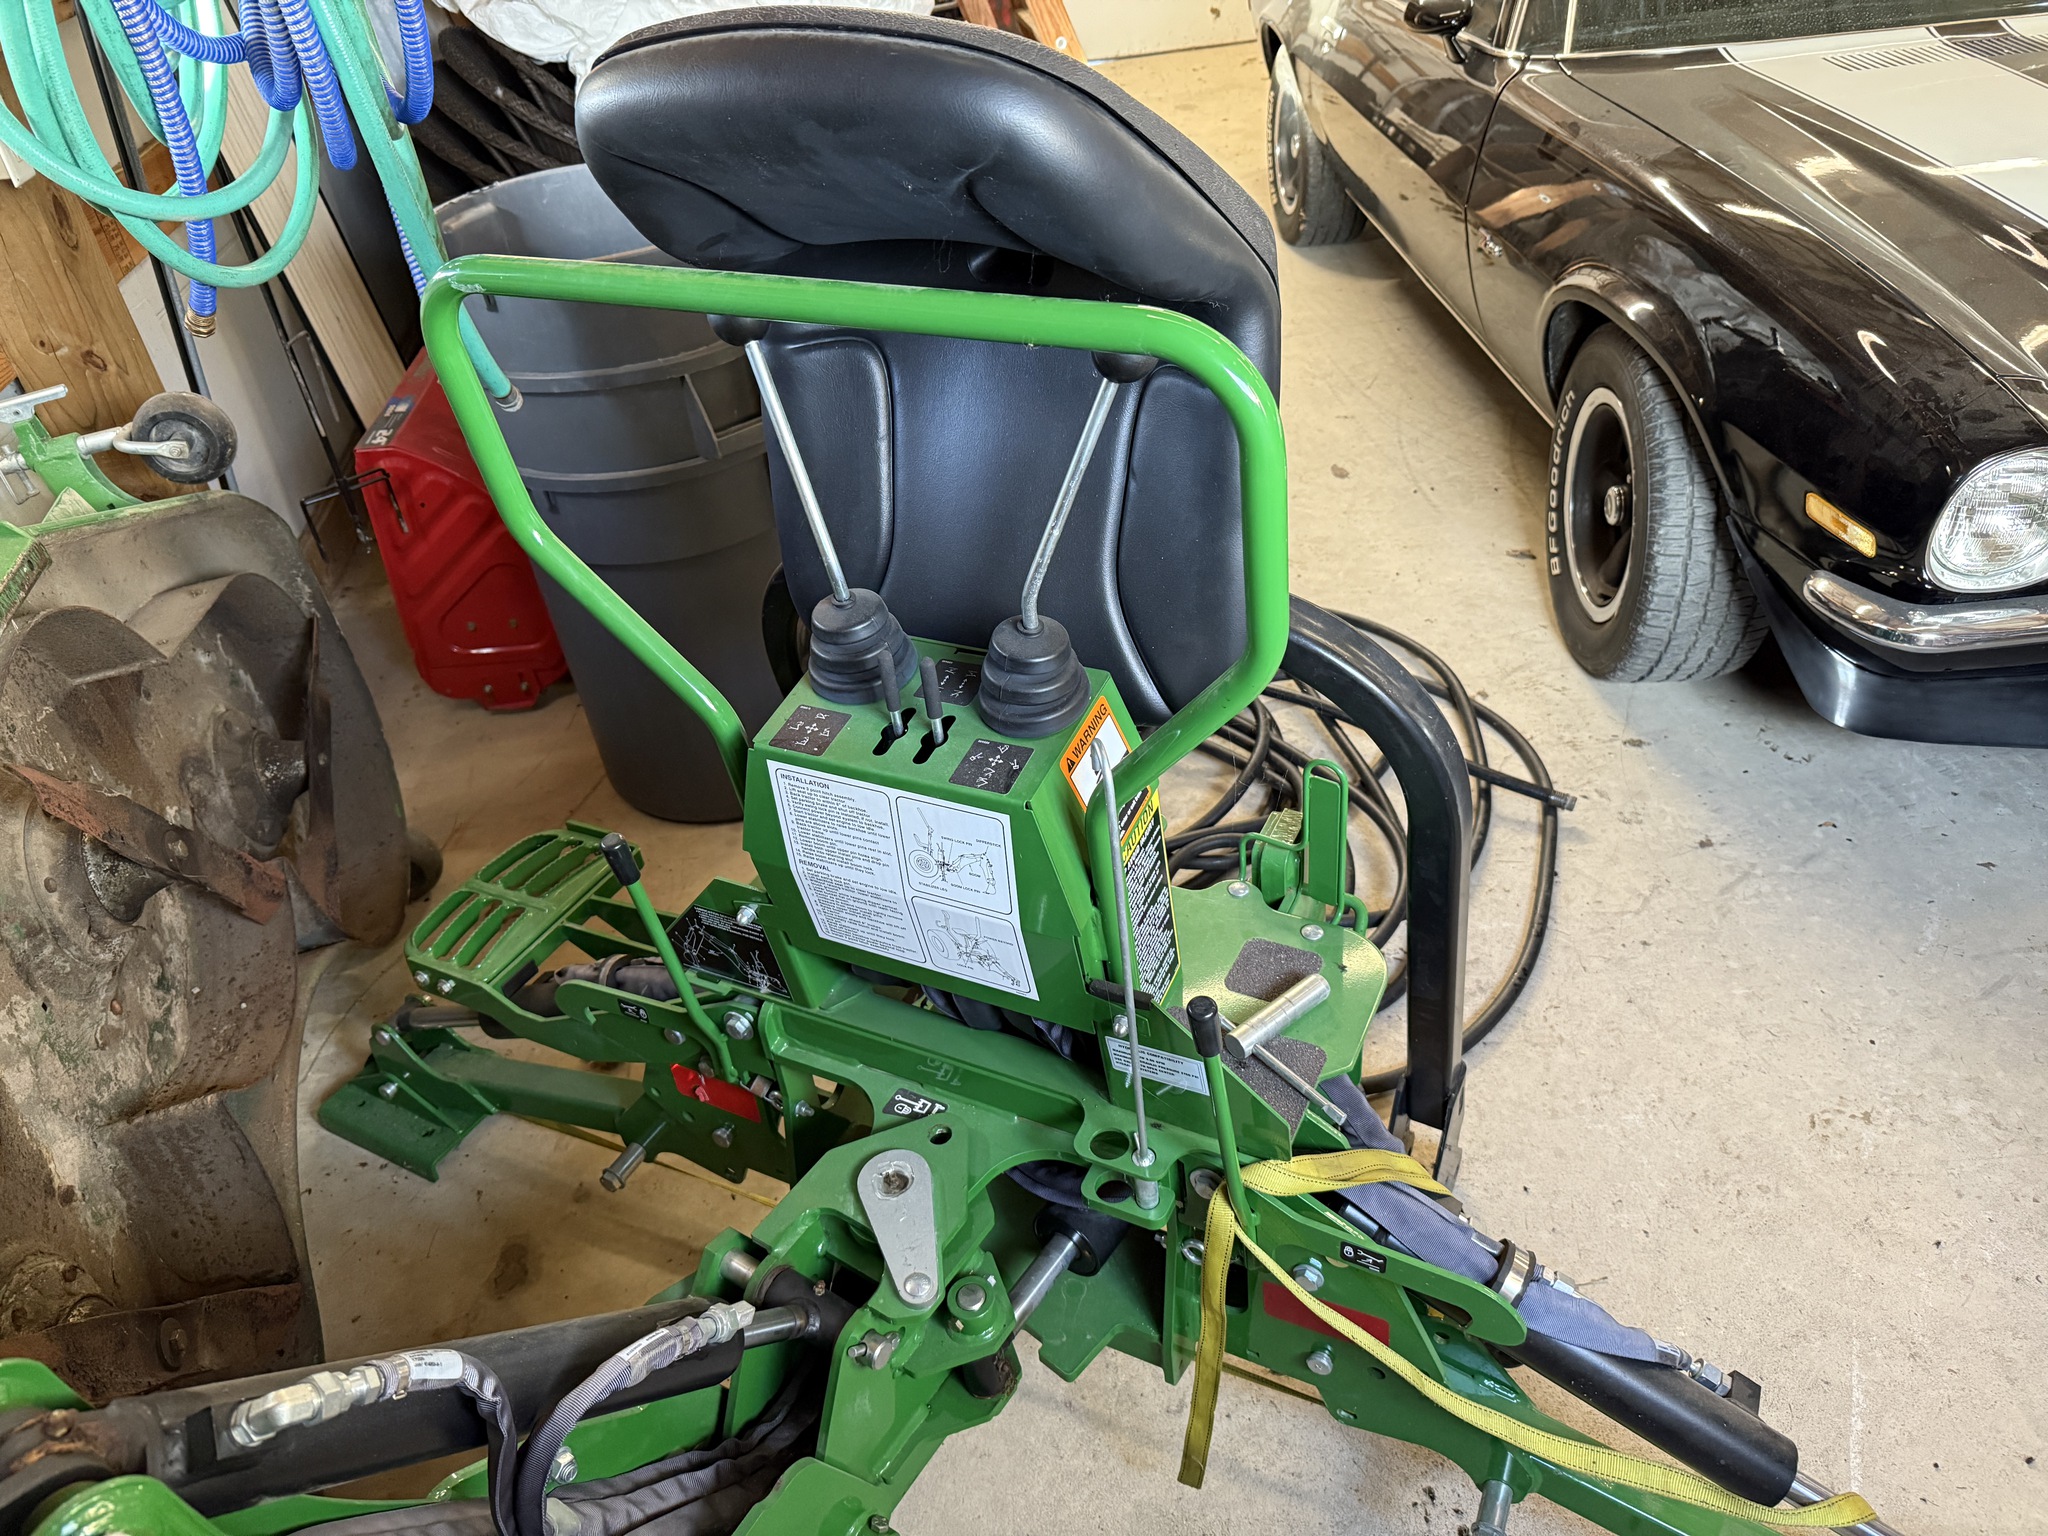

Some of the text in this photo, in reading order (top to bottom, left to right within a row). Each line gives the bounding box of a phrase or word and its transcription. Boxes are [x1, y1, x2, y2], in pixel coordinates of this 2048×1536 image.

[1548, 389, 1576, 576] BFGoodrich
[1072, 703, 1108, 759] WARNING
[780, 773, 830, 790] INSTALLATION
[1123, 800, 1154, 860] AUTION
[798, 859, 831, 872] REMOVAL
[1146, 1051, 1184, 1065] COMPATIBILITY
